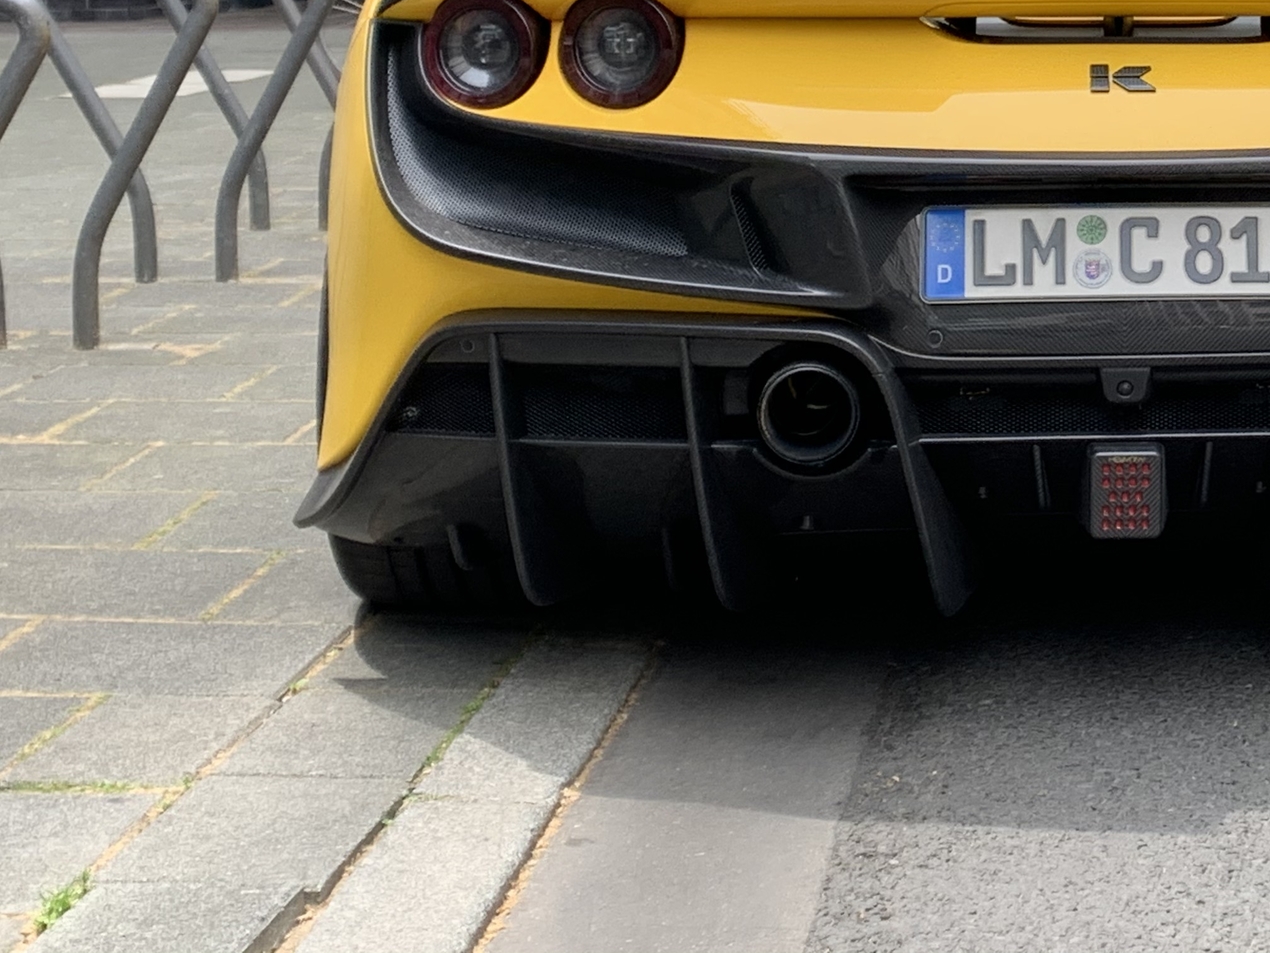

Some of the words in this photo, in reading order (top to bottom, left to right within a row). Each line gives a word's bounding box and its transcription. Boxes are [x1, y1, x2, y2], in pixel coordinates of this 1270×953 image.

[937, 264, 952, 284] D
[972, 217, 1067, 287] LM
[1119, 216, 1164, 284] C
